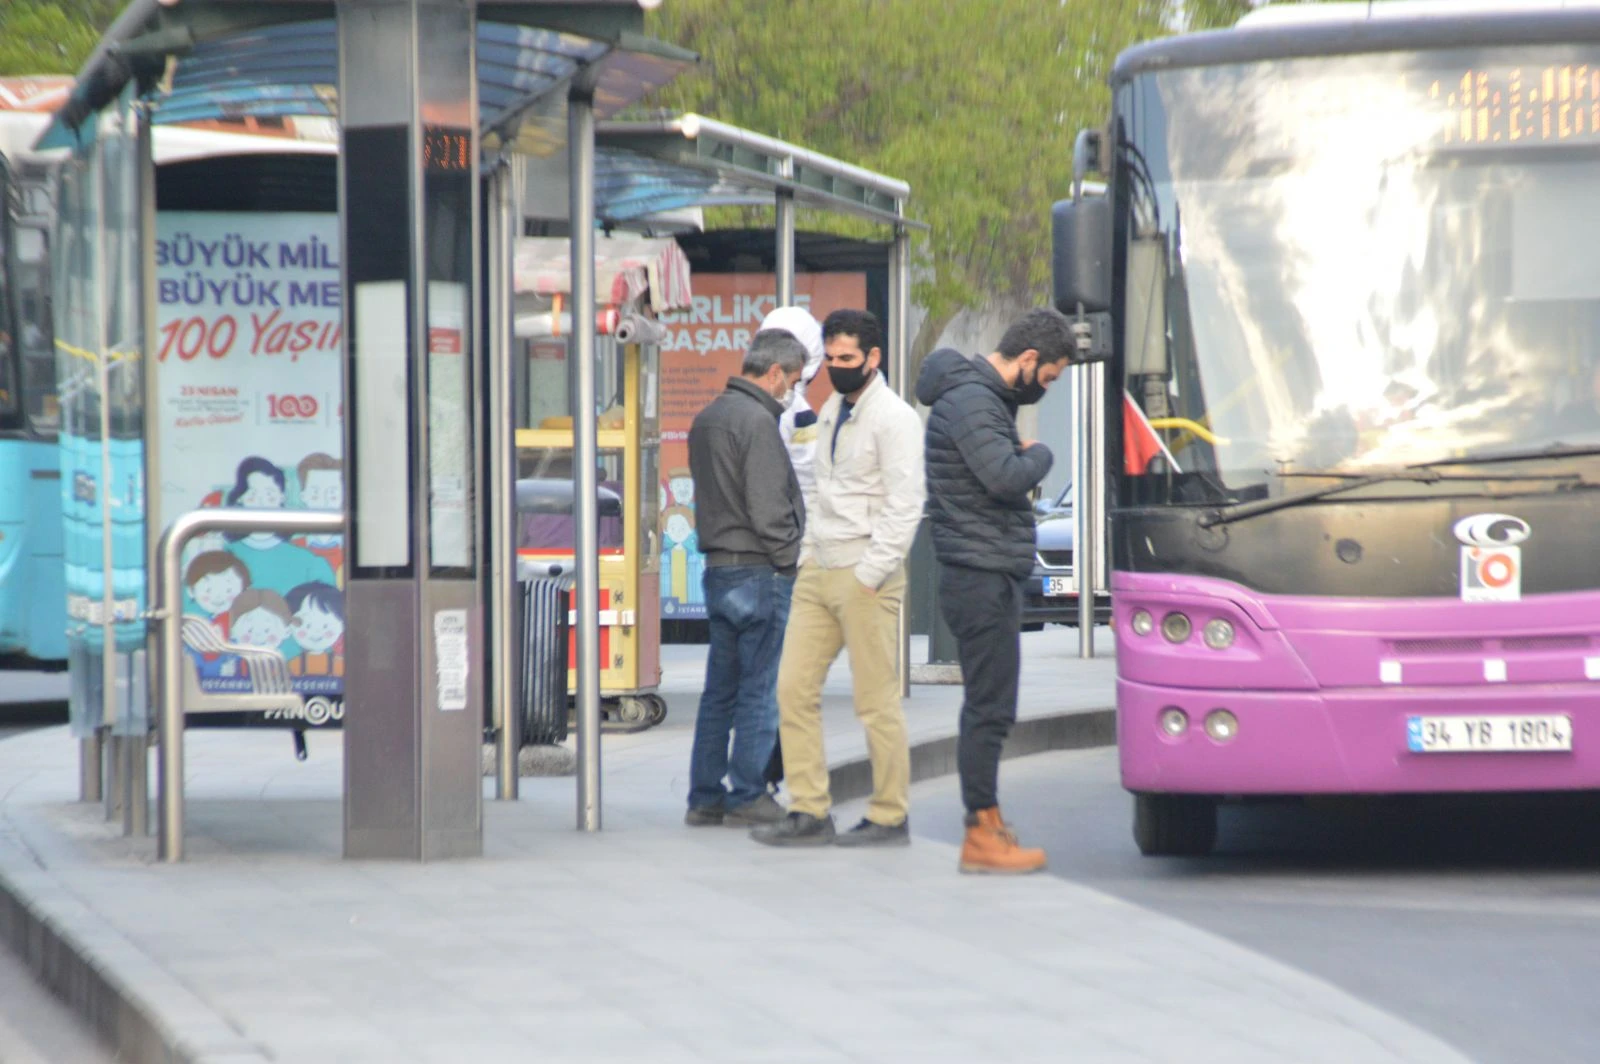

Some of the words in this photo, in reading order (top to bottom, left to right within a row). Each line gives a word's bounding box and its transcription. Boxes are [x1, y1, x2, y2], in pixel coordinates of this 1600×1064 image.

[155, 233, 270, 268] BÜYÜK
[279, 235, 340, 268] MİL
[158, 271, 280, 306] BÜYÜK
[289, 280, 340, 306] ME
[158, 314, 237, 362] 100
[1051, 579, 1063, 592] 35
[1425, 720, 1451, 746] 34
[1464, 720, 1493, 746] YB
[1509, 720, 1564, 746] 1804
